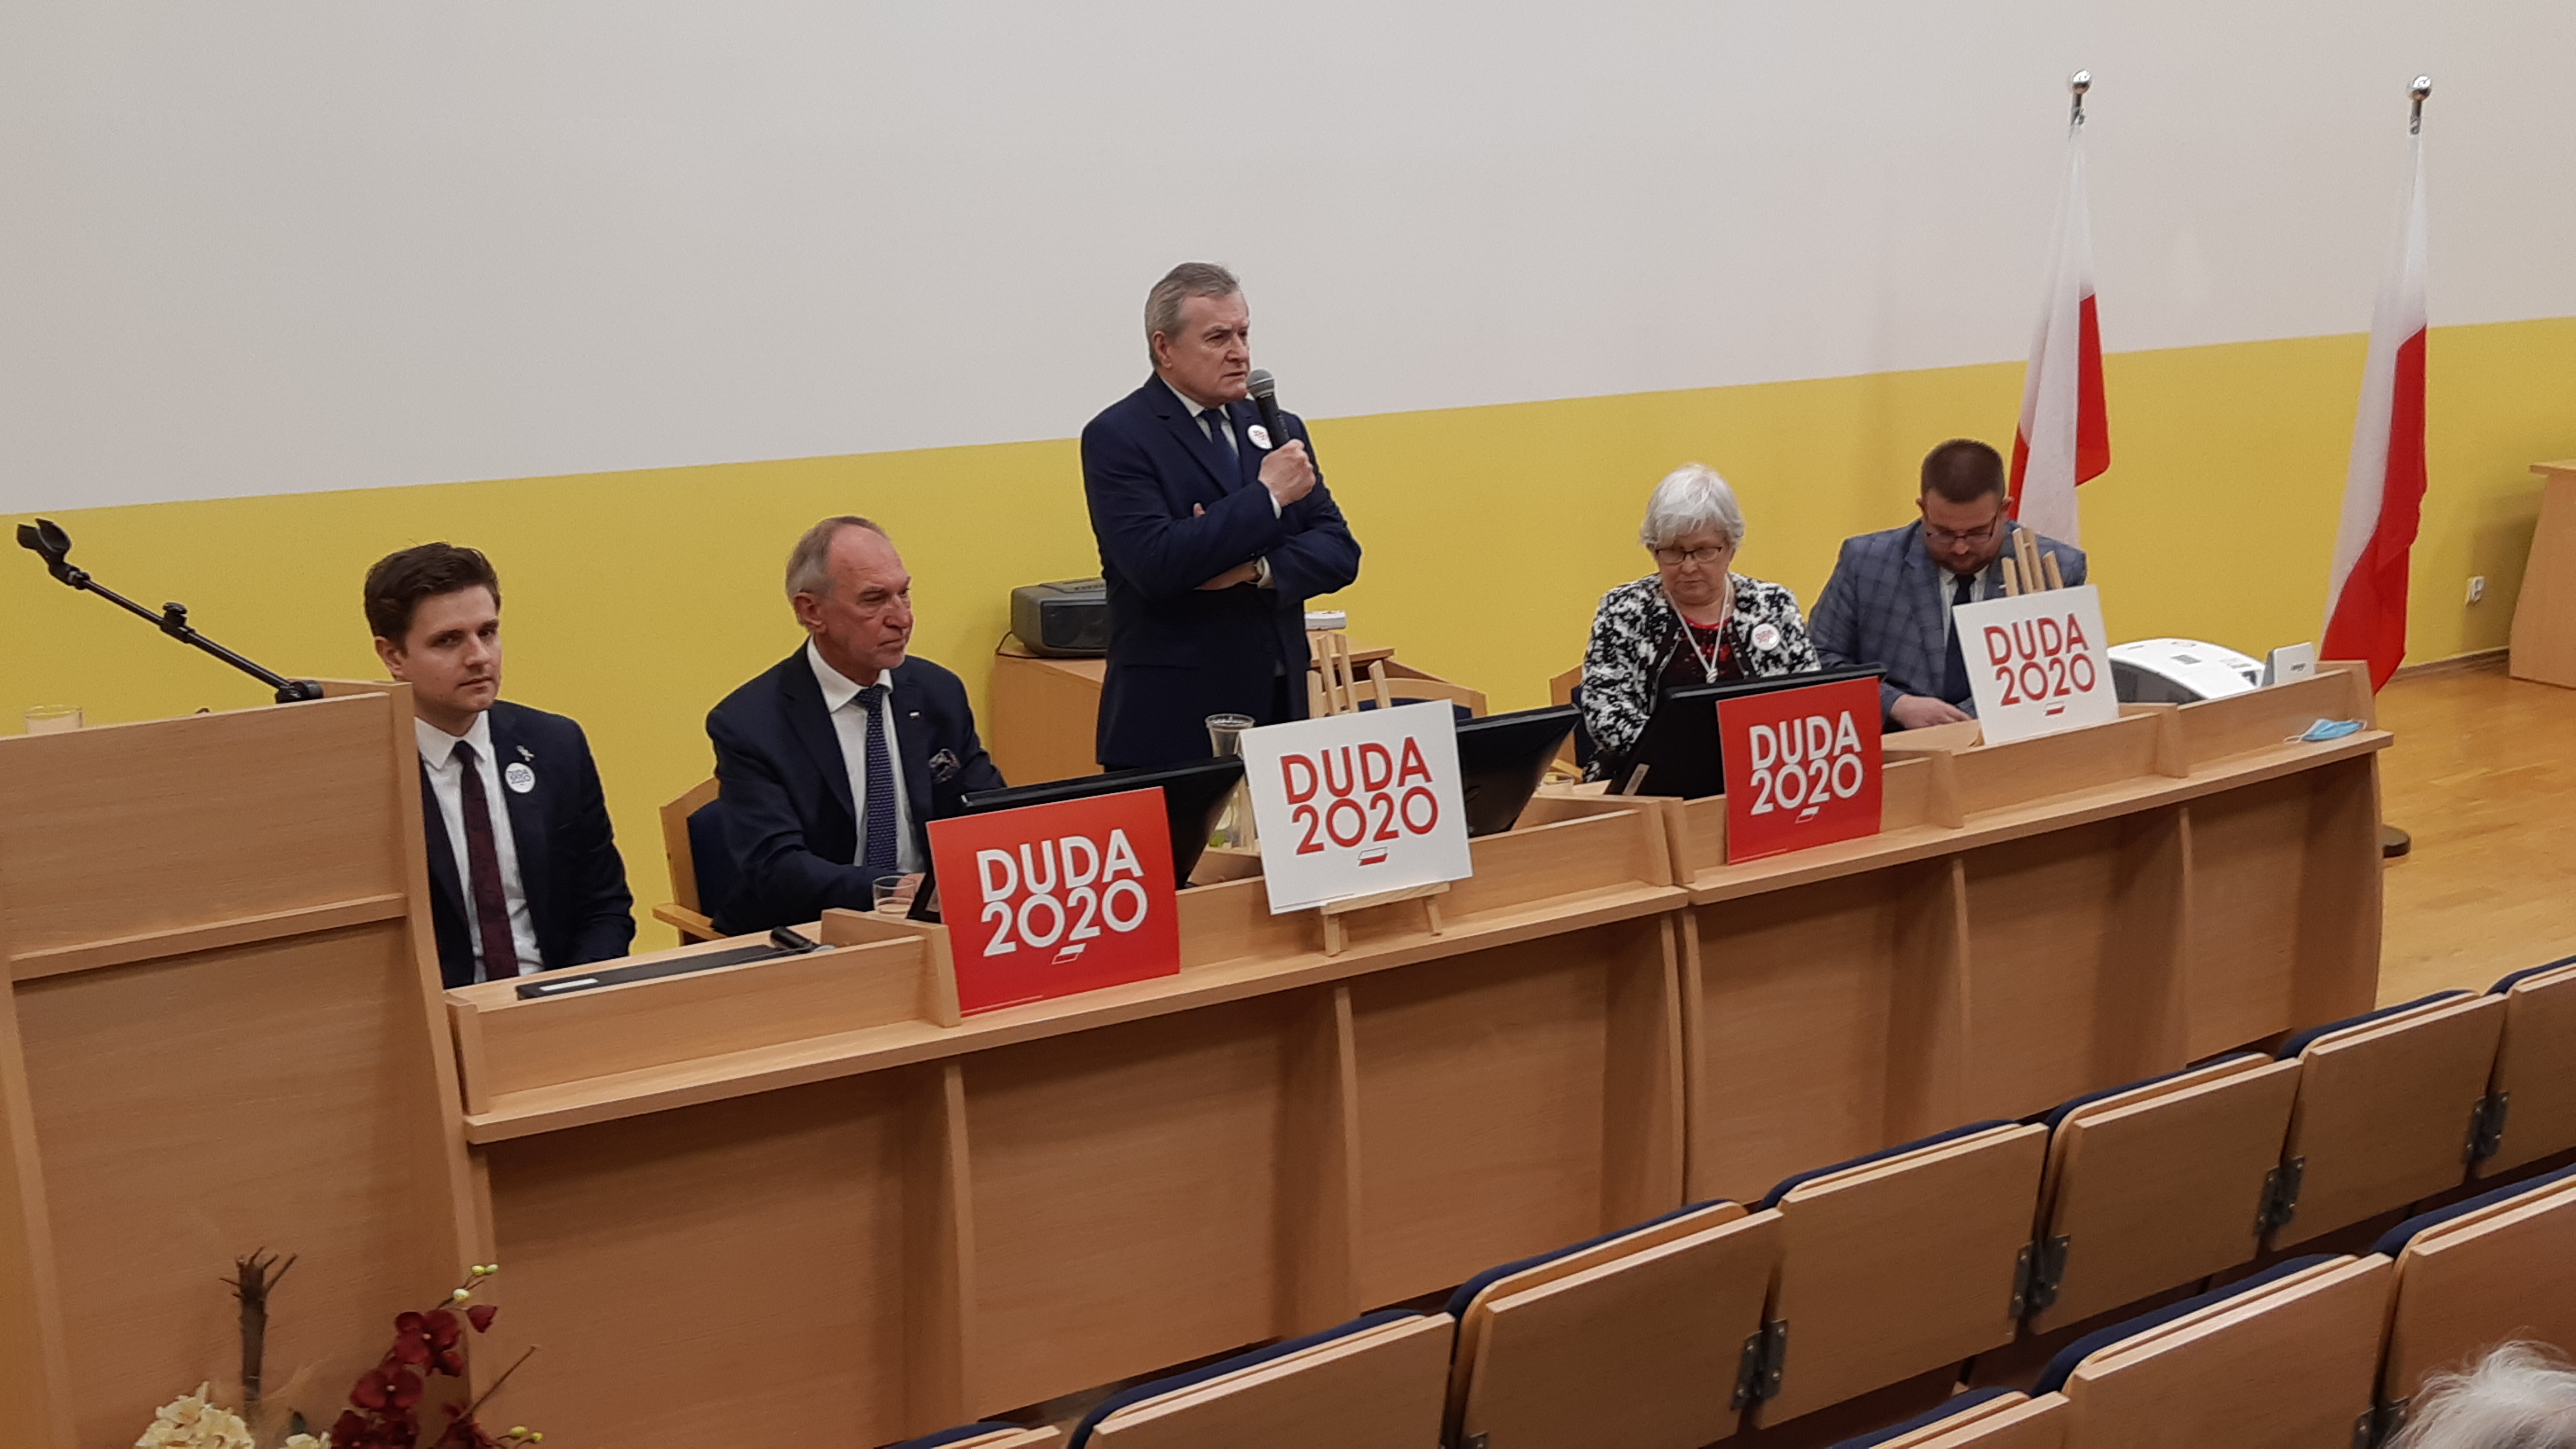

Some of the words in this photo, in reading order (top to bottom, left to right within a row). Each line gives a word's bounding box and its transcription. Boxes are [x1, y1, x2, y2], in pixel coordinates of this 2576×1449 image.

[1983, 613, 2089, 666] DUDA
[1996, 653, 2096, 706] 2020
[1281, 737, 1433, 804] DUDA
[1749, 711, 1862, 770] DUDA
[1750, 753, 1863, 815] 2020
[1292, 786, 1439, 855] 2020
[976, 828, 1144, 903] DUDA
[981, 879, 1148, 957] 2020
